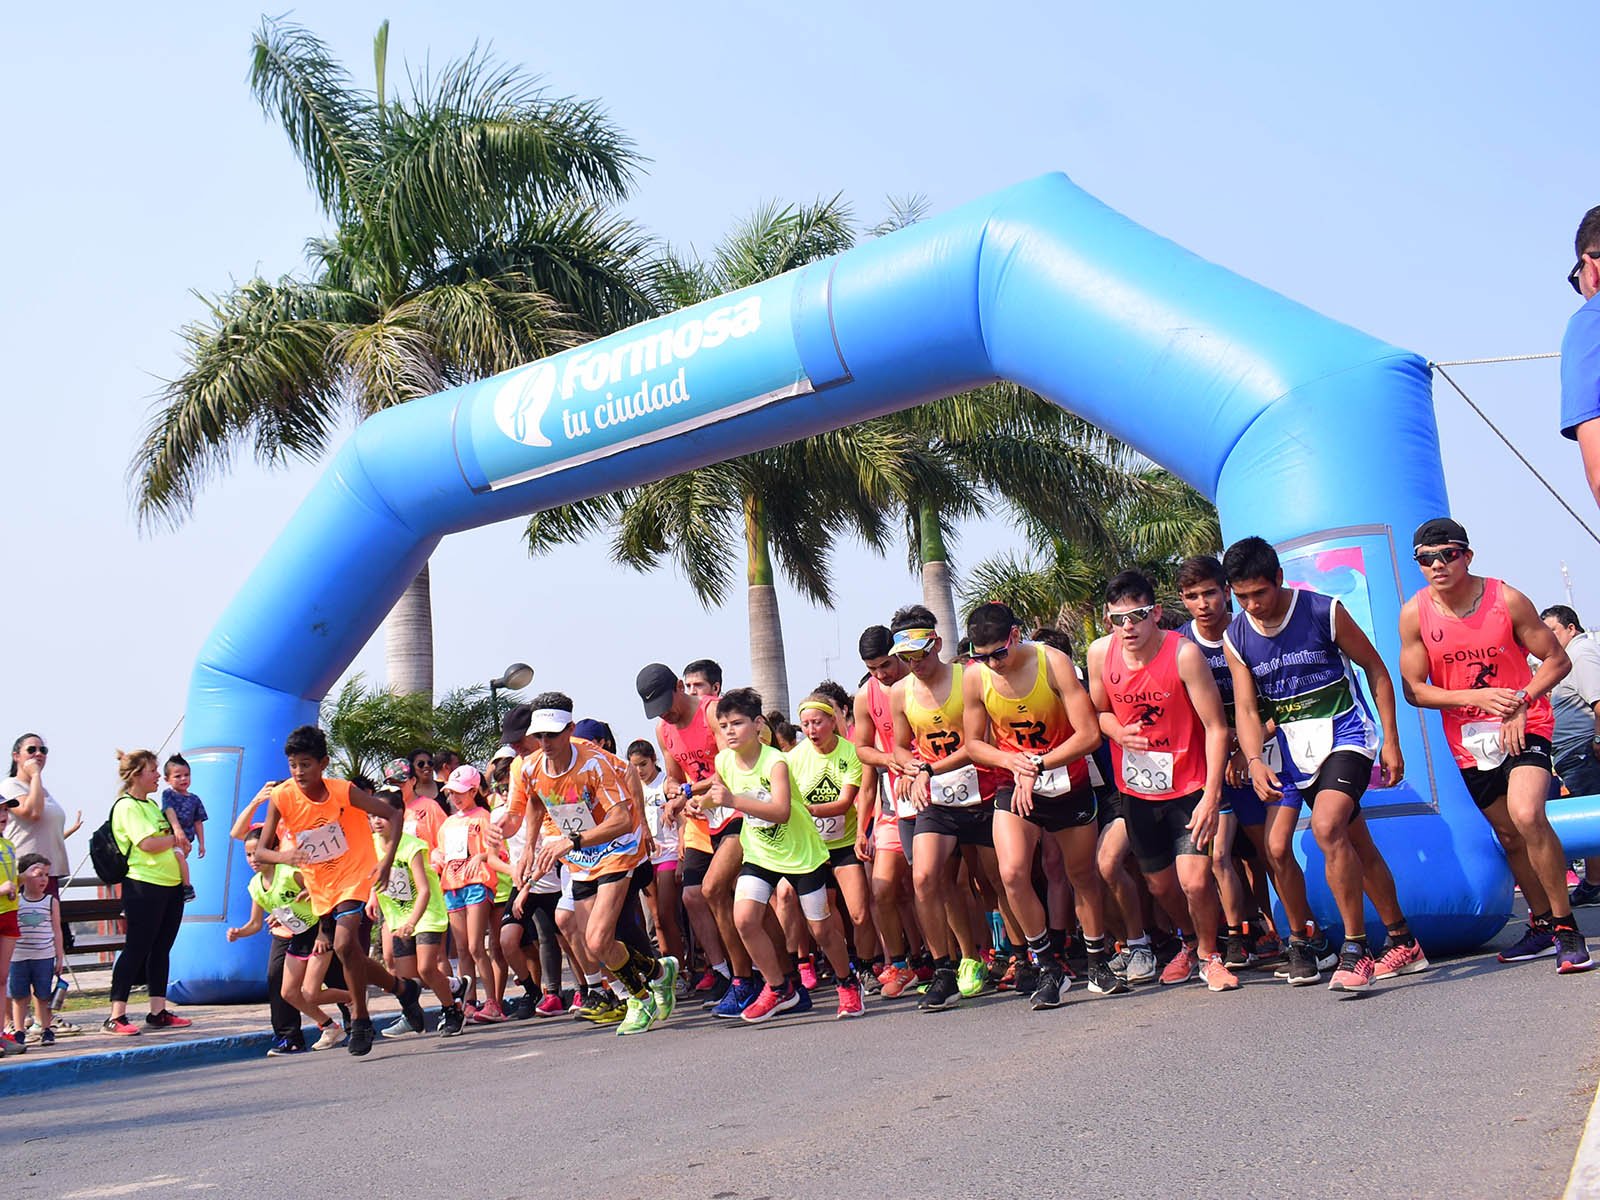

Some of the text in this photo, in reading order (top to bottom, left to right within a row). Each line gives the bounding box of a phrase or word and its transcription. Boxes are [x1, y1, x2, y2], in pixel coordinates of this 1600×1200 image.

[560, 295, 762, 399] Formosa
[562, 367, 690, 439] tu ciudad
[1443, 646, 1498, 664] SONIC
[1113, 691, 1163, 704] SONIC
[1147, 737, 1170, 748] AM
[674, 749, 705, 762] SONIC
[822, 779, 830, 788] A
[1126, 766, 1169, 791] 233
[815, 787, 838, 795] TODA
[942, 783, 970, 804] 93
[562, 817, 588, 833] 42
[814, 817, 837, 834] 92
[304, 835, 341, 858] 211
[388, 880, 408, 895] 32
